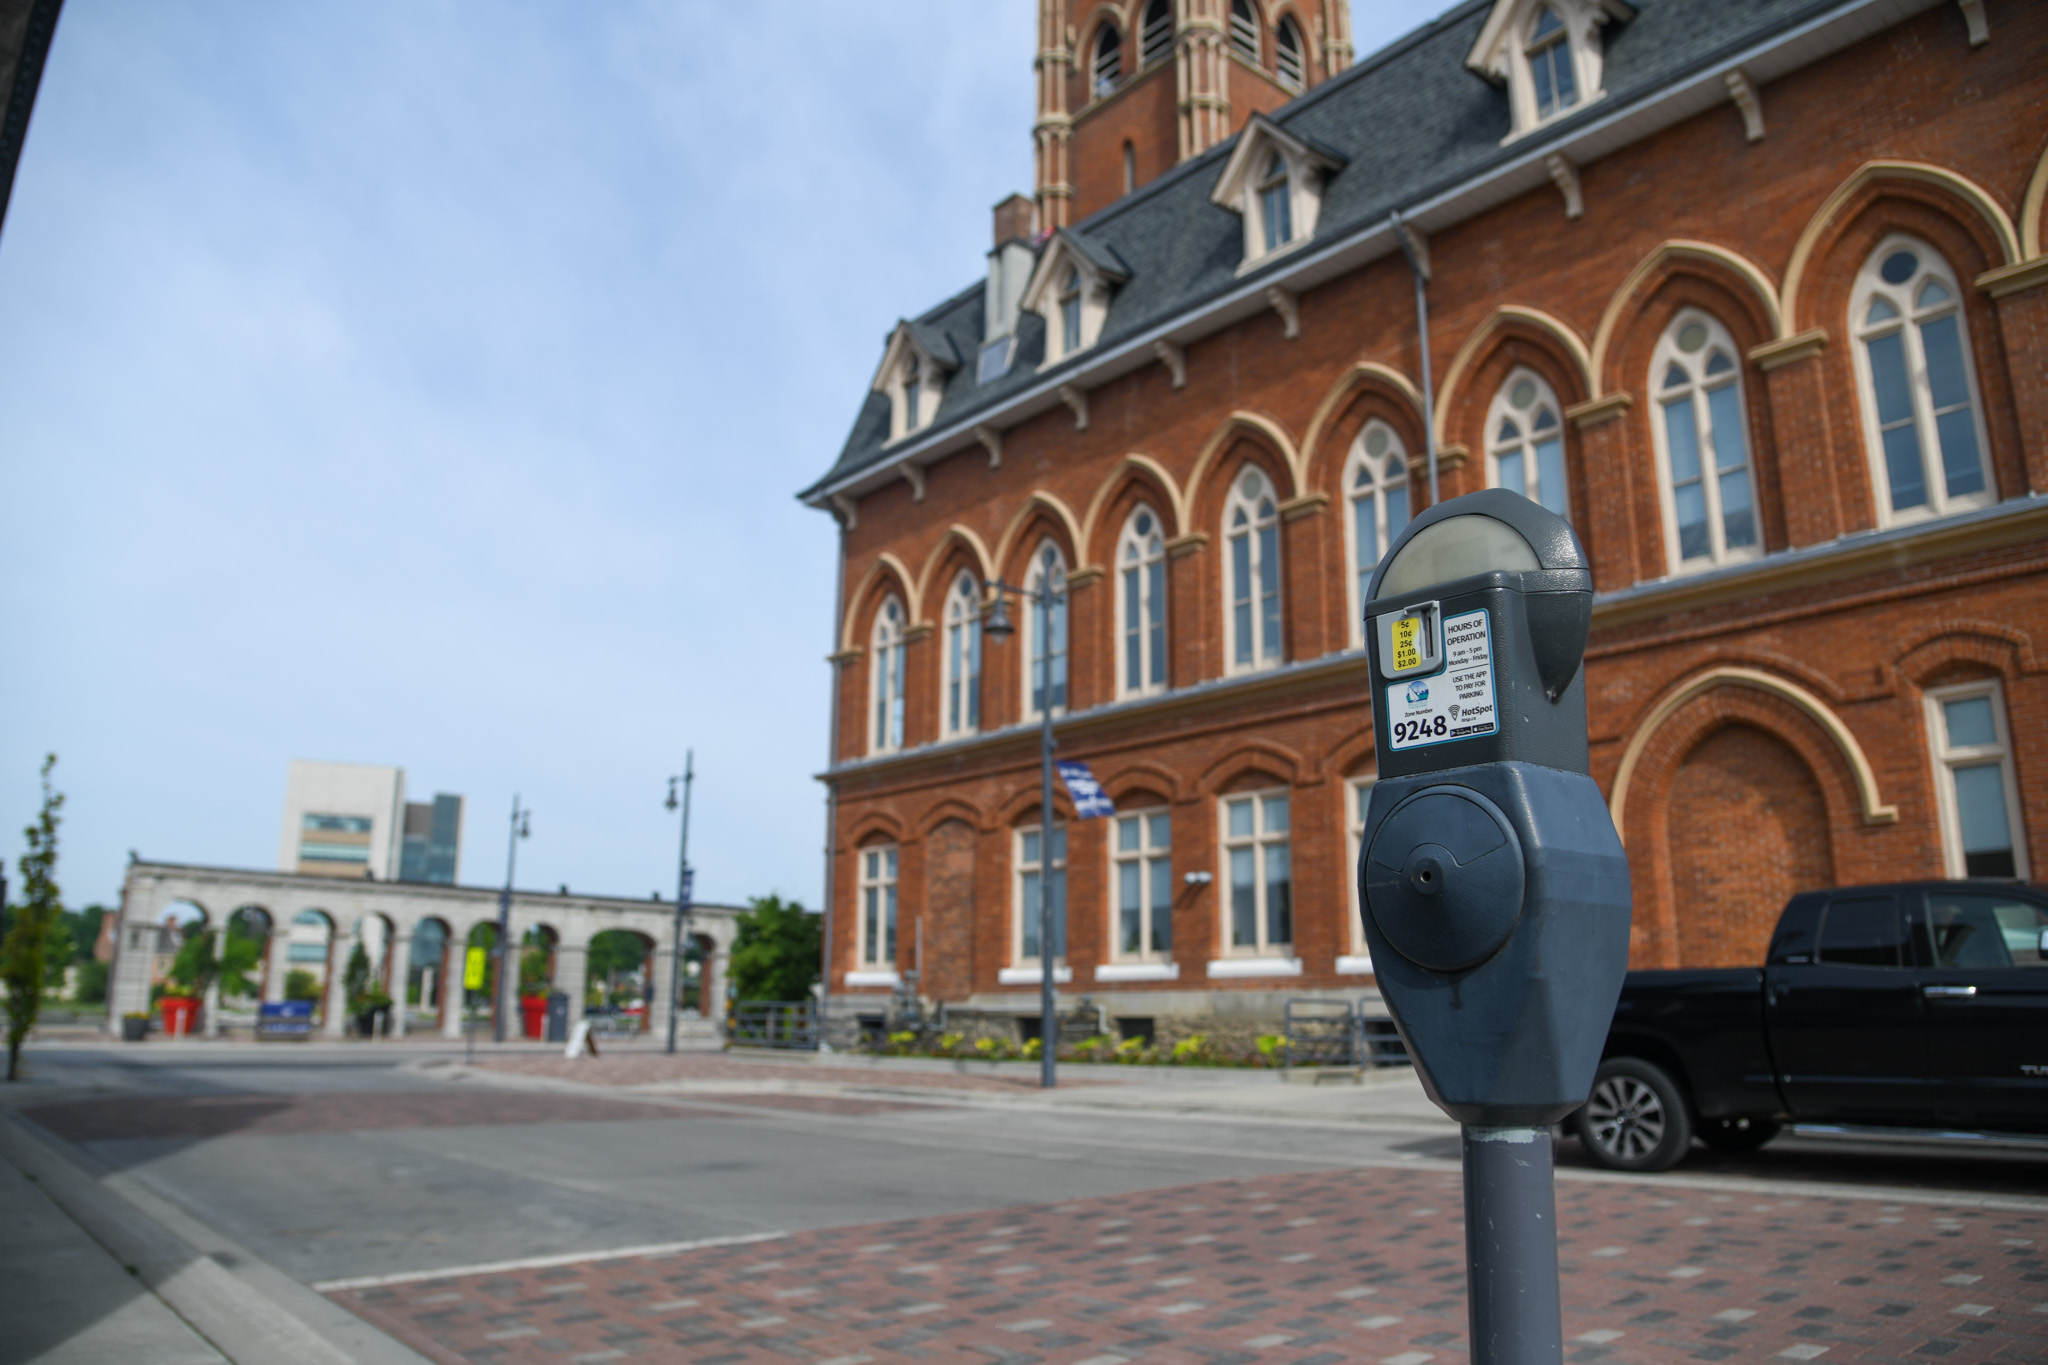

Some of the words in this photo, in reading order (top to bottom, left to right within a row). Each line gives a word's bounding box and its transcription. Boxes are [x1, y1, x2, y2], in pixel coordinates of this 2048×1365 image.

[1401, 621, 1409, 629] 5¢
[1448, 622, 1473, 634] HOURS
[1473, 619, 1483, 628] OF
[1400, 630, 1412, 638] 10¢
[1447, 631, 1486, 646] OPERATION
[1400, 639, 1412, 648] 25¢
[1397, 648, 1416, 659] $1.00
[1473, 646, 1482, 654] pm
[1398, 658, 1416, 668] $2.00
[1448, 657, 1469, 666] Monday
[1472, 653, 1488, 662] Friday
[1452, 675, 1463, 683] USE
[1475, 670, 1487, 678] APP
[1463, 682, 1473, 690] PAY
[1474, 680, 1486, 688] FOR
[1459, 690, 1483, 700] PARKING
[1461, 704, 1493, 716] HotSpot
[1394, 715, 1447, 744] 9248
